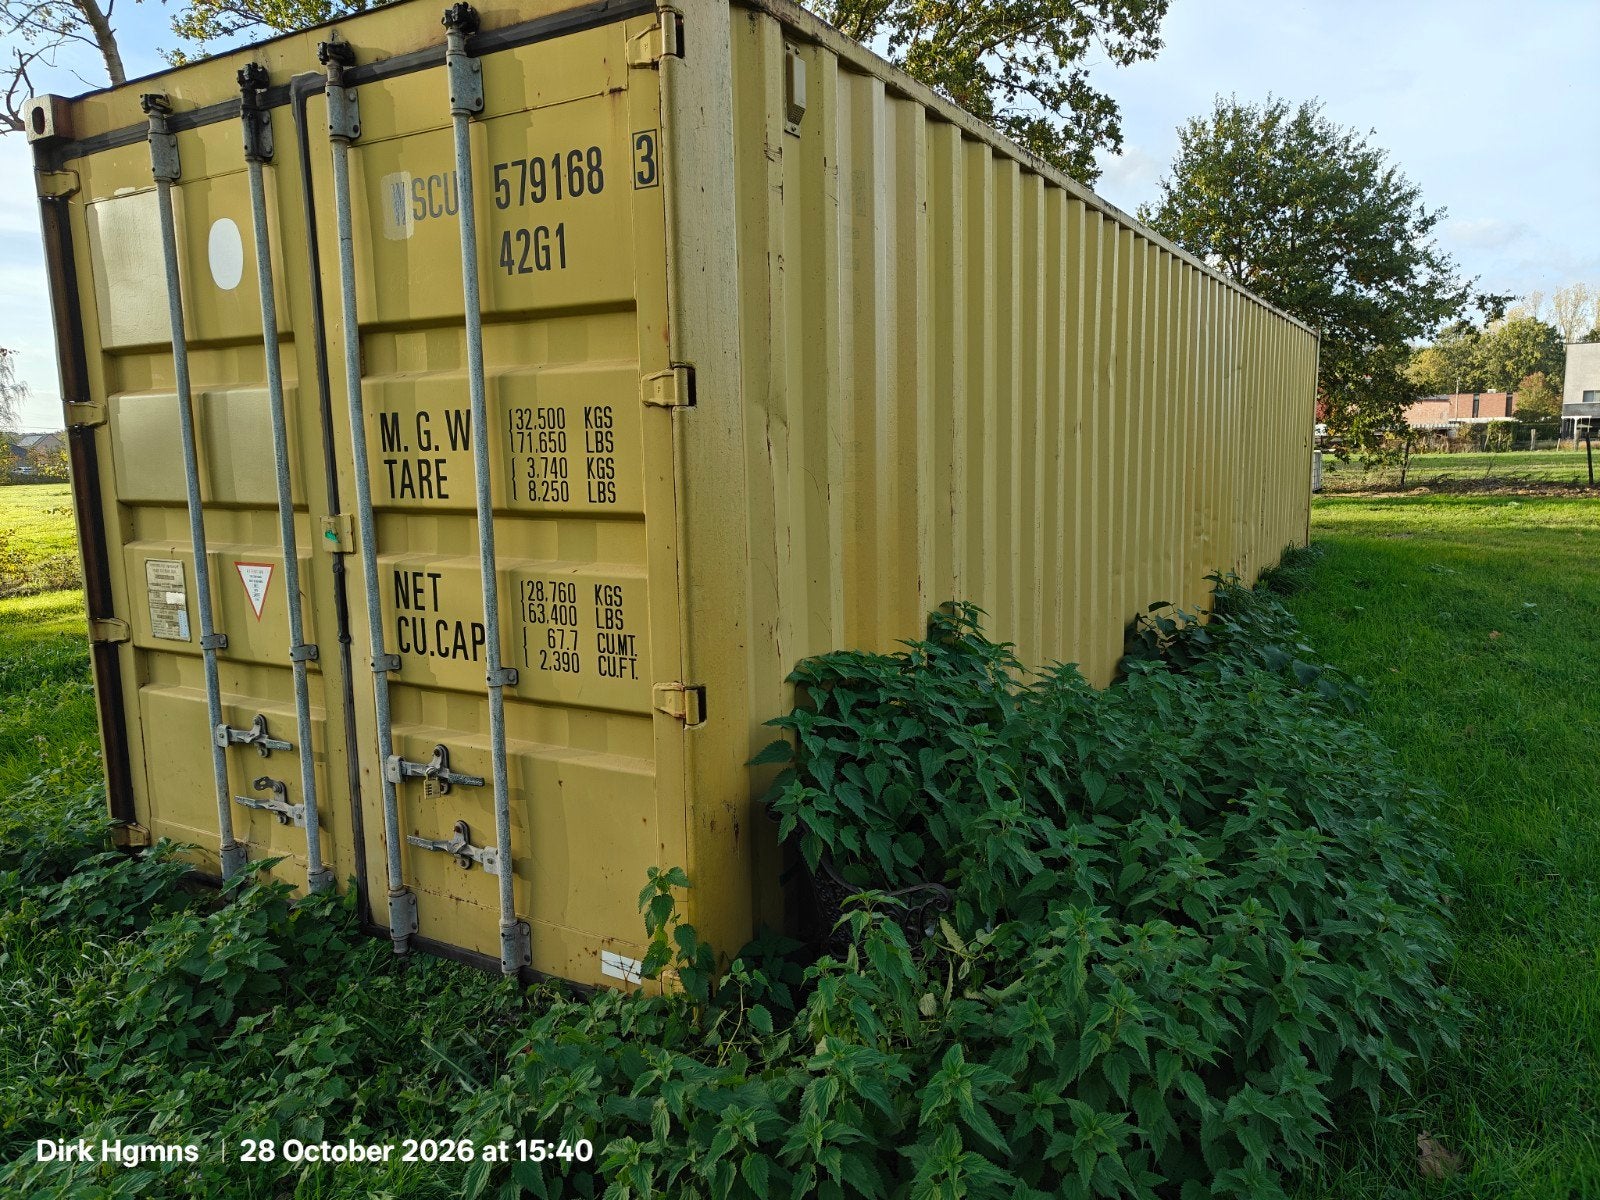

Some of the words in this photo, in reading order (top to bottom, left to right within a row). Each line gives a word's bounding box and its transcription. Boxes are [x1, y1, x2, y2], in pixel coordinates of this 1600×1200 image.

[391, 171, 459, 226] SCU
[494, 146, 604, 210] 579168
[635, 134, 656, 185] 3
[500, 223, 566, 276] 42G1
[584, 406, 613, 430] KGS
[586, 431, 614, 453] LBS
[384, 459, 449, 499] TARE
[586, 457, 615, 480] KGS
[588, 481, 617, 503] LBS
[394, 571, 441, 612] NET
[595, 584, 623, 607] KGS
[596, 608, 624, 630] LBS
[547, 628, 578, 651] 67.7
[597, 632, 638, 657] CU.MT.
[598, 655, 639, 680] CU.FT.
